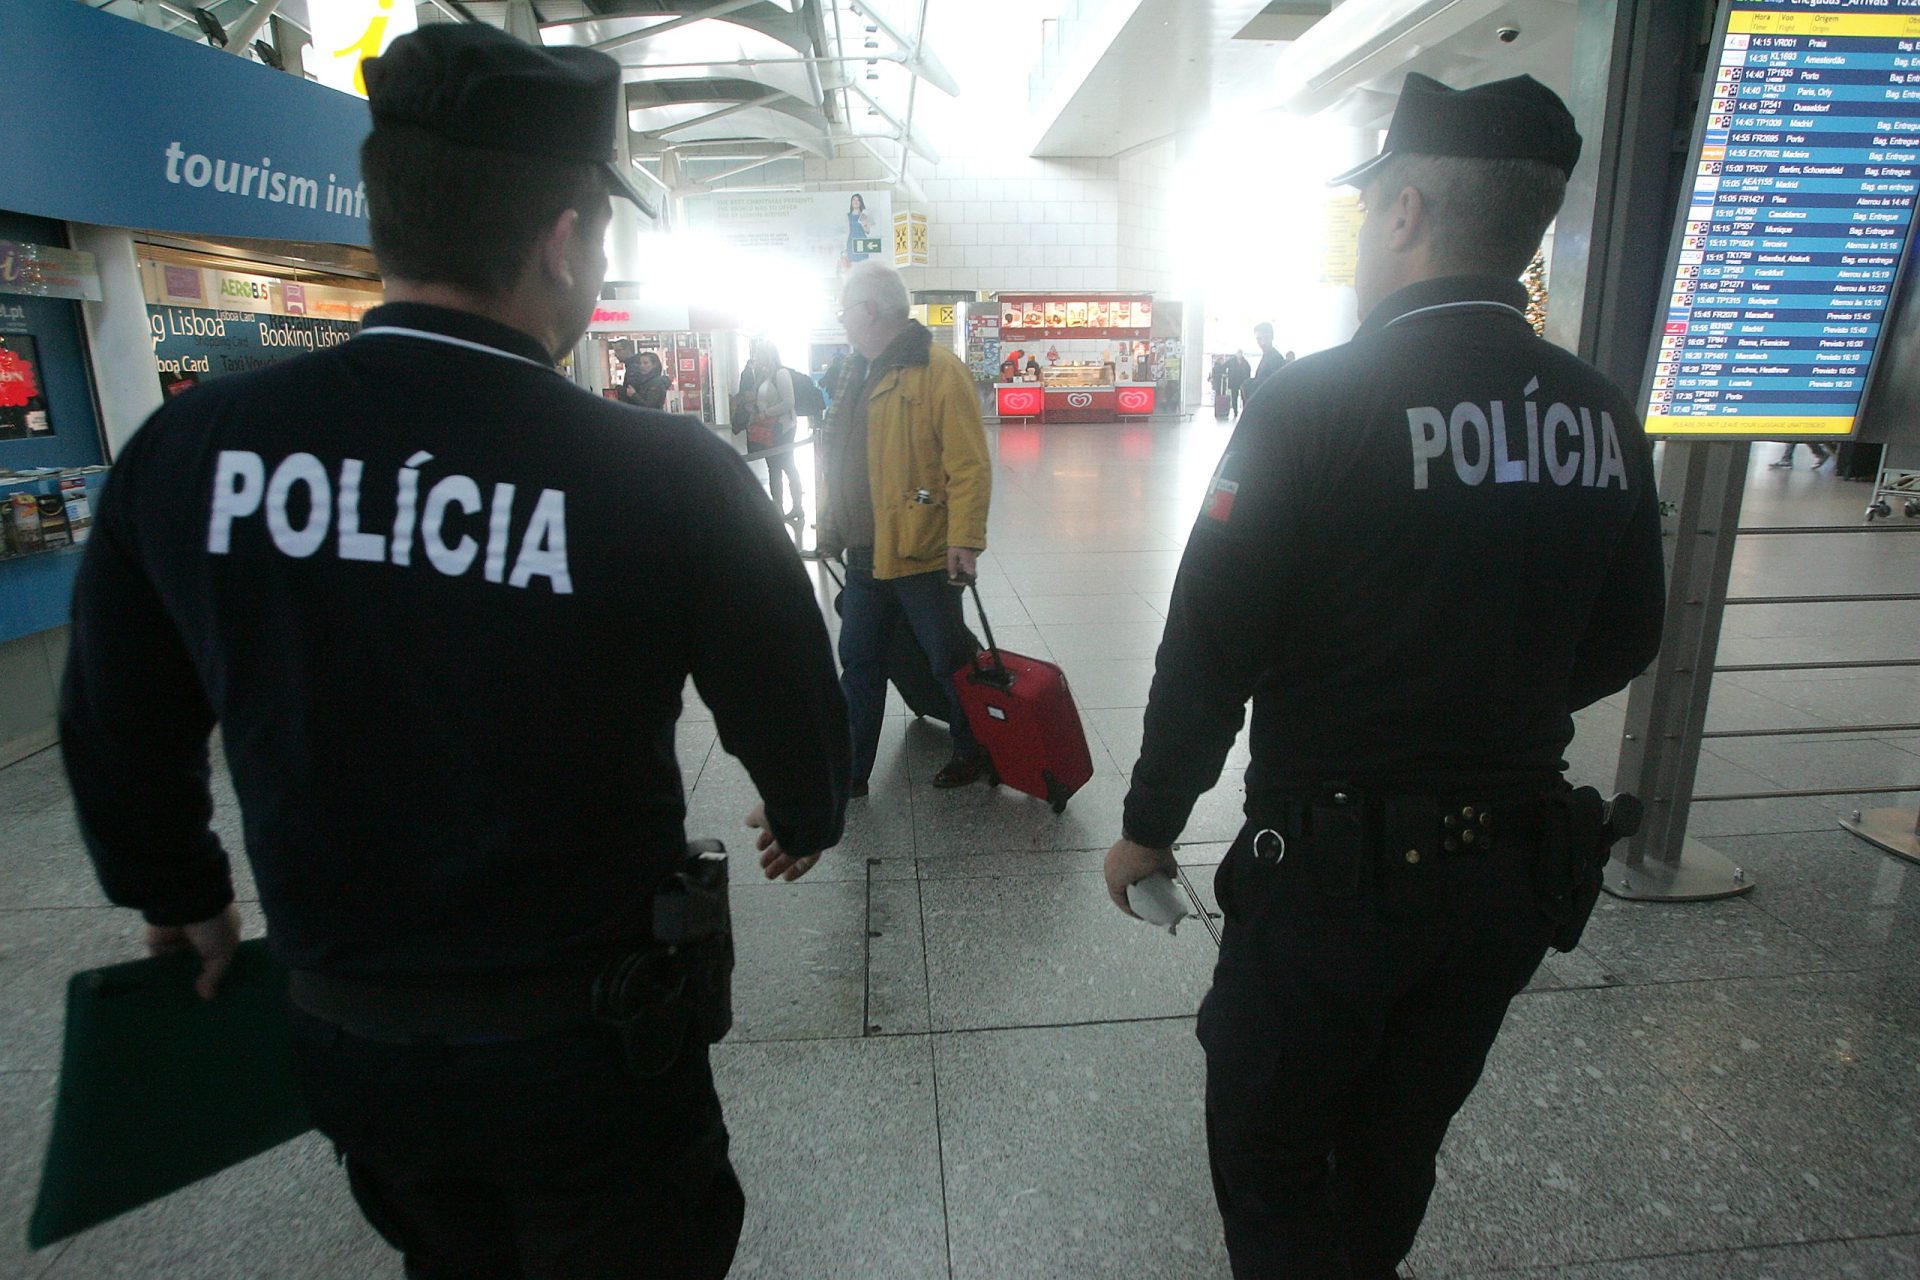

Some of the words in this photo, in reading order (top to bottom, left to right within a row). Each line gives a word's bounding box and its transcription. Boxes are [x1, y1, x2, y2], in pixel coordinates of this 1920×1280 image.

[1814, 15, 1839, 23] Origem
[1752, 38, 1771, 46] 14:15
[1773, 39, 1798, 47] VR001
[1808, 39, 1827, 48] Praia
[1898, 41, 1914, 52] Bag.
[1749, 54, 1768, 62] 14:35
[1894, 57, 1909, 67] Bag.
[1746, 70, 1765, 79] 14:40
[1767, 68, 1794, 77] TP1935
[1801, 72, 1820, 80] Porto
[1889, 74, 1905, 84] Bag.
[1742, 86, 1761, 94] 14:40
[1818, 88, 1832, 97] Orly
[1885, 89, 1900, 99] Bag.
[1739, 102, 1758, 110] 14:45
[1793, 104, 1831, 112] Dusseldorf
[1735, 118, 1754, 127] 14:45
[1789, 120, 1814, 128] Madrid
[1877, 121, 1892, 131] Bag.
[1732, 134, 1751, 142] 14:55
[1786, 135, 1805, 143] Porto
[1873, 137, 1888, 146] Bag.
[1889, 137, 1919, 146] Entregue
[1728, 149, 1747, 157] 14:55
[1782, 150, 1810, 159] Madeira
[1868, 152, 1884, 162] Bag.
[1885, 153, 1916, 161] Entregue
[165, 141, 319, 209] tourism
[1864, 167, 1879, 176] Bag.
[1881, 168, 1911, 177] Entregue
[1722, 180, 1741, 188] 15:05
[1775, 181, 1799, 189] Madrid
[1718, 195, 1737, 203] 15:05
[1772, 196, 1787, 204] Pisa
[1891, 198, 1910, 206] 14:46
[1715, 209, 1734, 217] 15:10
[1768, 211, 1807, 219] Casablanca
[1869, 213, 1899, 222] Entregue
[1765, 226, 1793, 235] Munique
[1865, 228, 1894, 237] Entregue
[1709, 239, 1727, 247] 15:15
[1762, 240, 1787, 248] Terceira
[1706, 253, 1724, 261] 15:15
[1703, 268, 1721, 276] 15:25
[1699, 282, 1718, 290] 15:40
[1751, 283, 1771, 291] Viena
[168, 308, 226, 337] Lisboa
[216, 309, 239, 322] Lisboa
[240, 312, 255, 323] Card
[1741, 325, 1764, 333] Madrid
[1823, 326, 1848, 334] Previsto
[259, 323, 313, 352] Booking
[314, 327, 350, 348] Lisboa
[182, 355, 209, 373] Card
[1407, 375, 1628, 491] POLÍCIA
[208, 450, 573, 594] POLÍCIA
